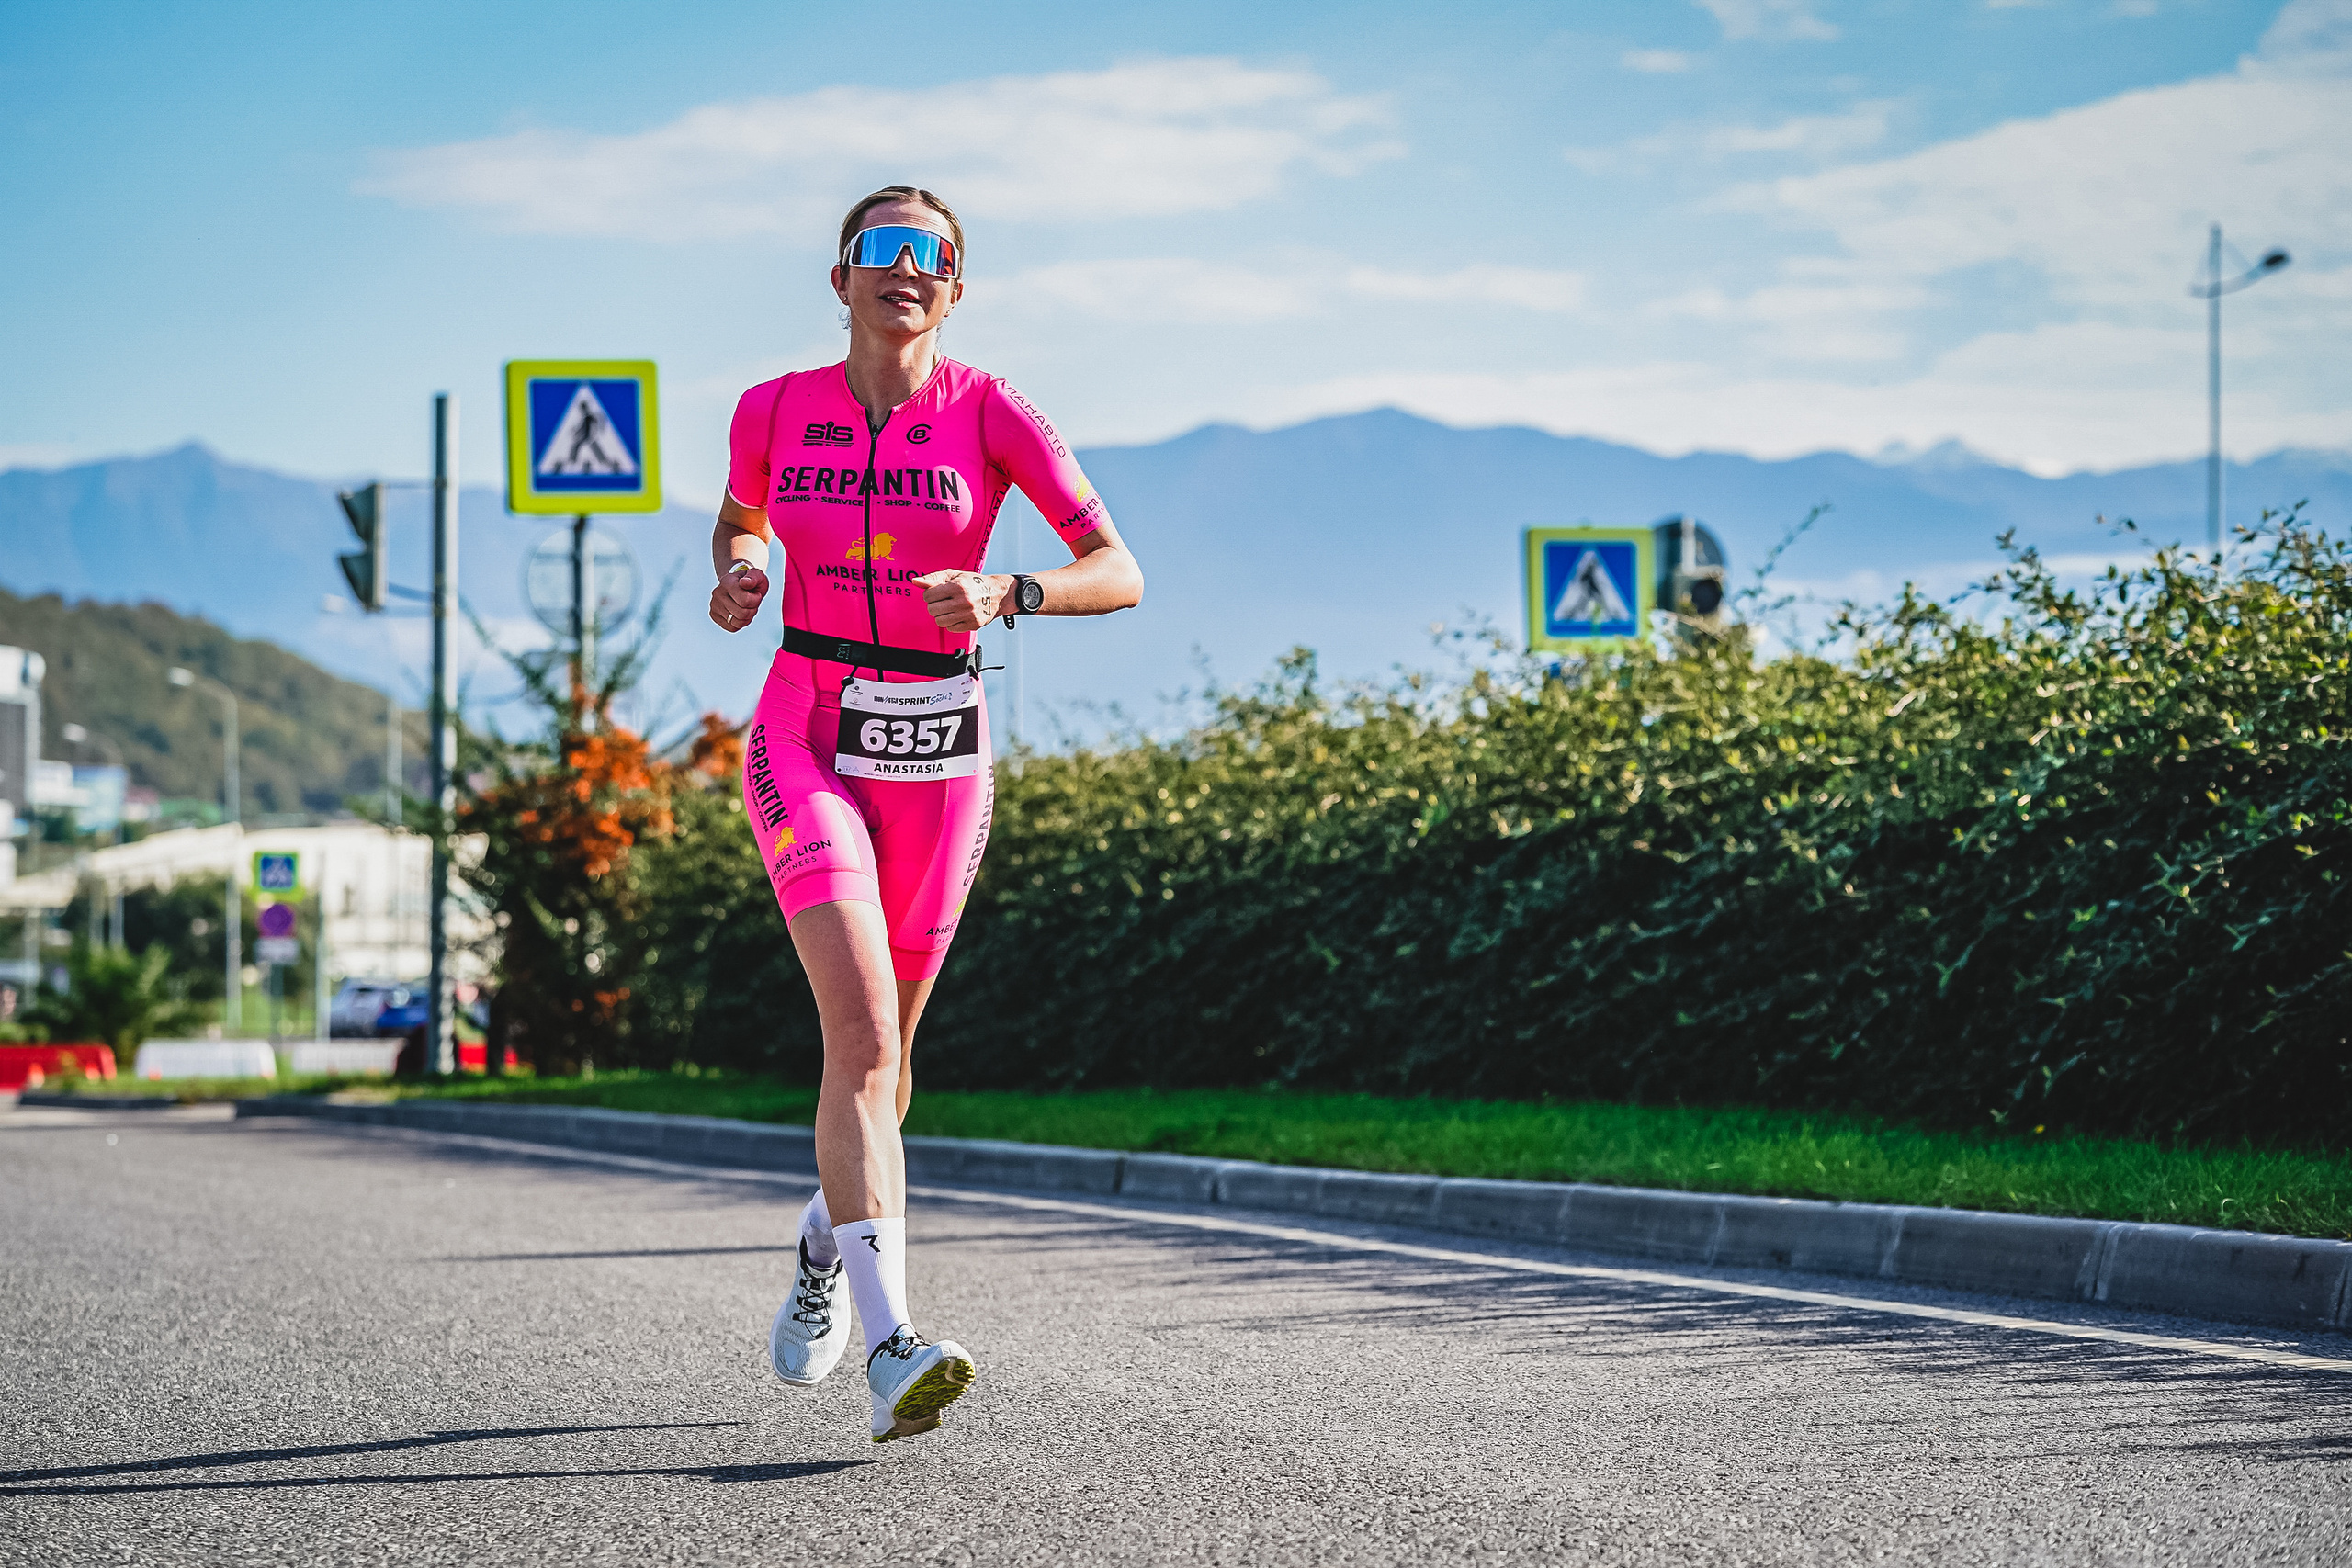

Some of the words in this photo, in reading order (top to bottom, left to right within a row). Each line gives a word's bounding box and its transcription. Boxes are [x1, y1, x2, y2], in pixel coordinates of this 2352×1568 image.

[777, 466, 960, 501] SERPANTIN
[775, 494, 811, 504] CYCLING
[820, 496, 864, 507] SERVICE
[884, 499, 912, 507] SHOP
[924, 502, 961, 513] COFFEE
[816, 564, 878, 581] AMBER
[888, 568, 927, 583] LIO
[833, 582, 912, 597] PARTNERS
[899, 696, 932, 705] SPRINT
[860, 715, 963, 755] 6357
[751, 723, 789, 829] SERPANTIN
[873, 763, 944, 774] ANASTASIA
[796, 840, 831, 857] LION
